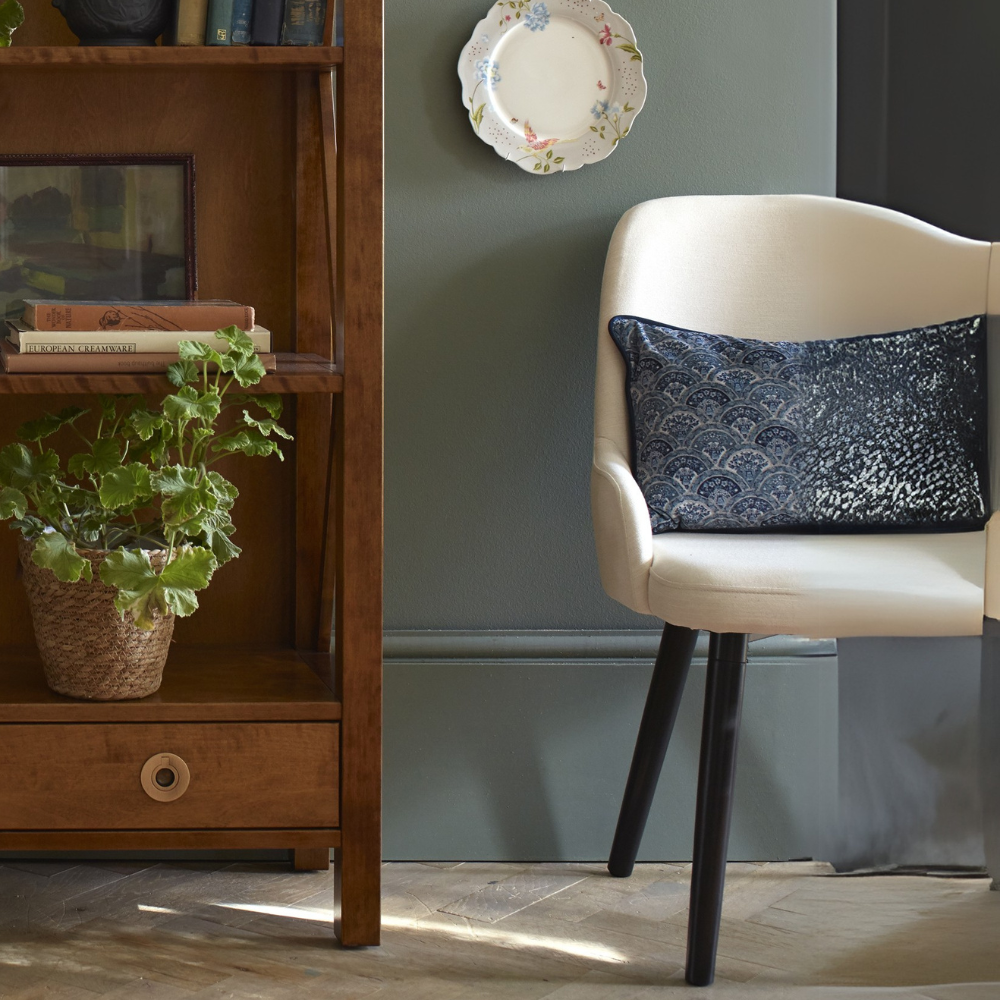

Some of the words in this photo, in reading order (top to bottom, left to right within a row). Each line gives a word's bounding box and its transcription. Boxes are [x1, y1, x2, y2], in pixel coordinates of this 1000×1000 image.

[29, 344, 75, 353] EUROPEAN
[77, 344, 133, 353] CREAMWARE
[155, 360, 166, 368] The
